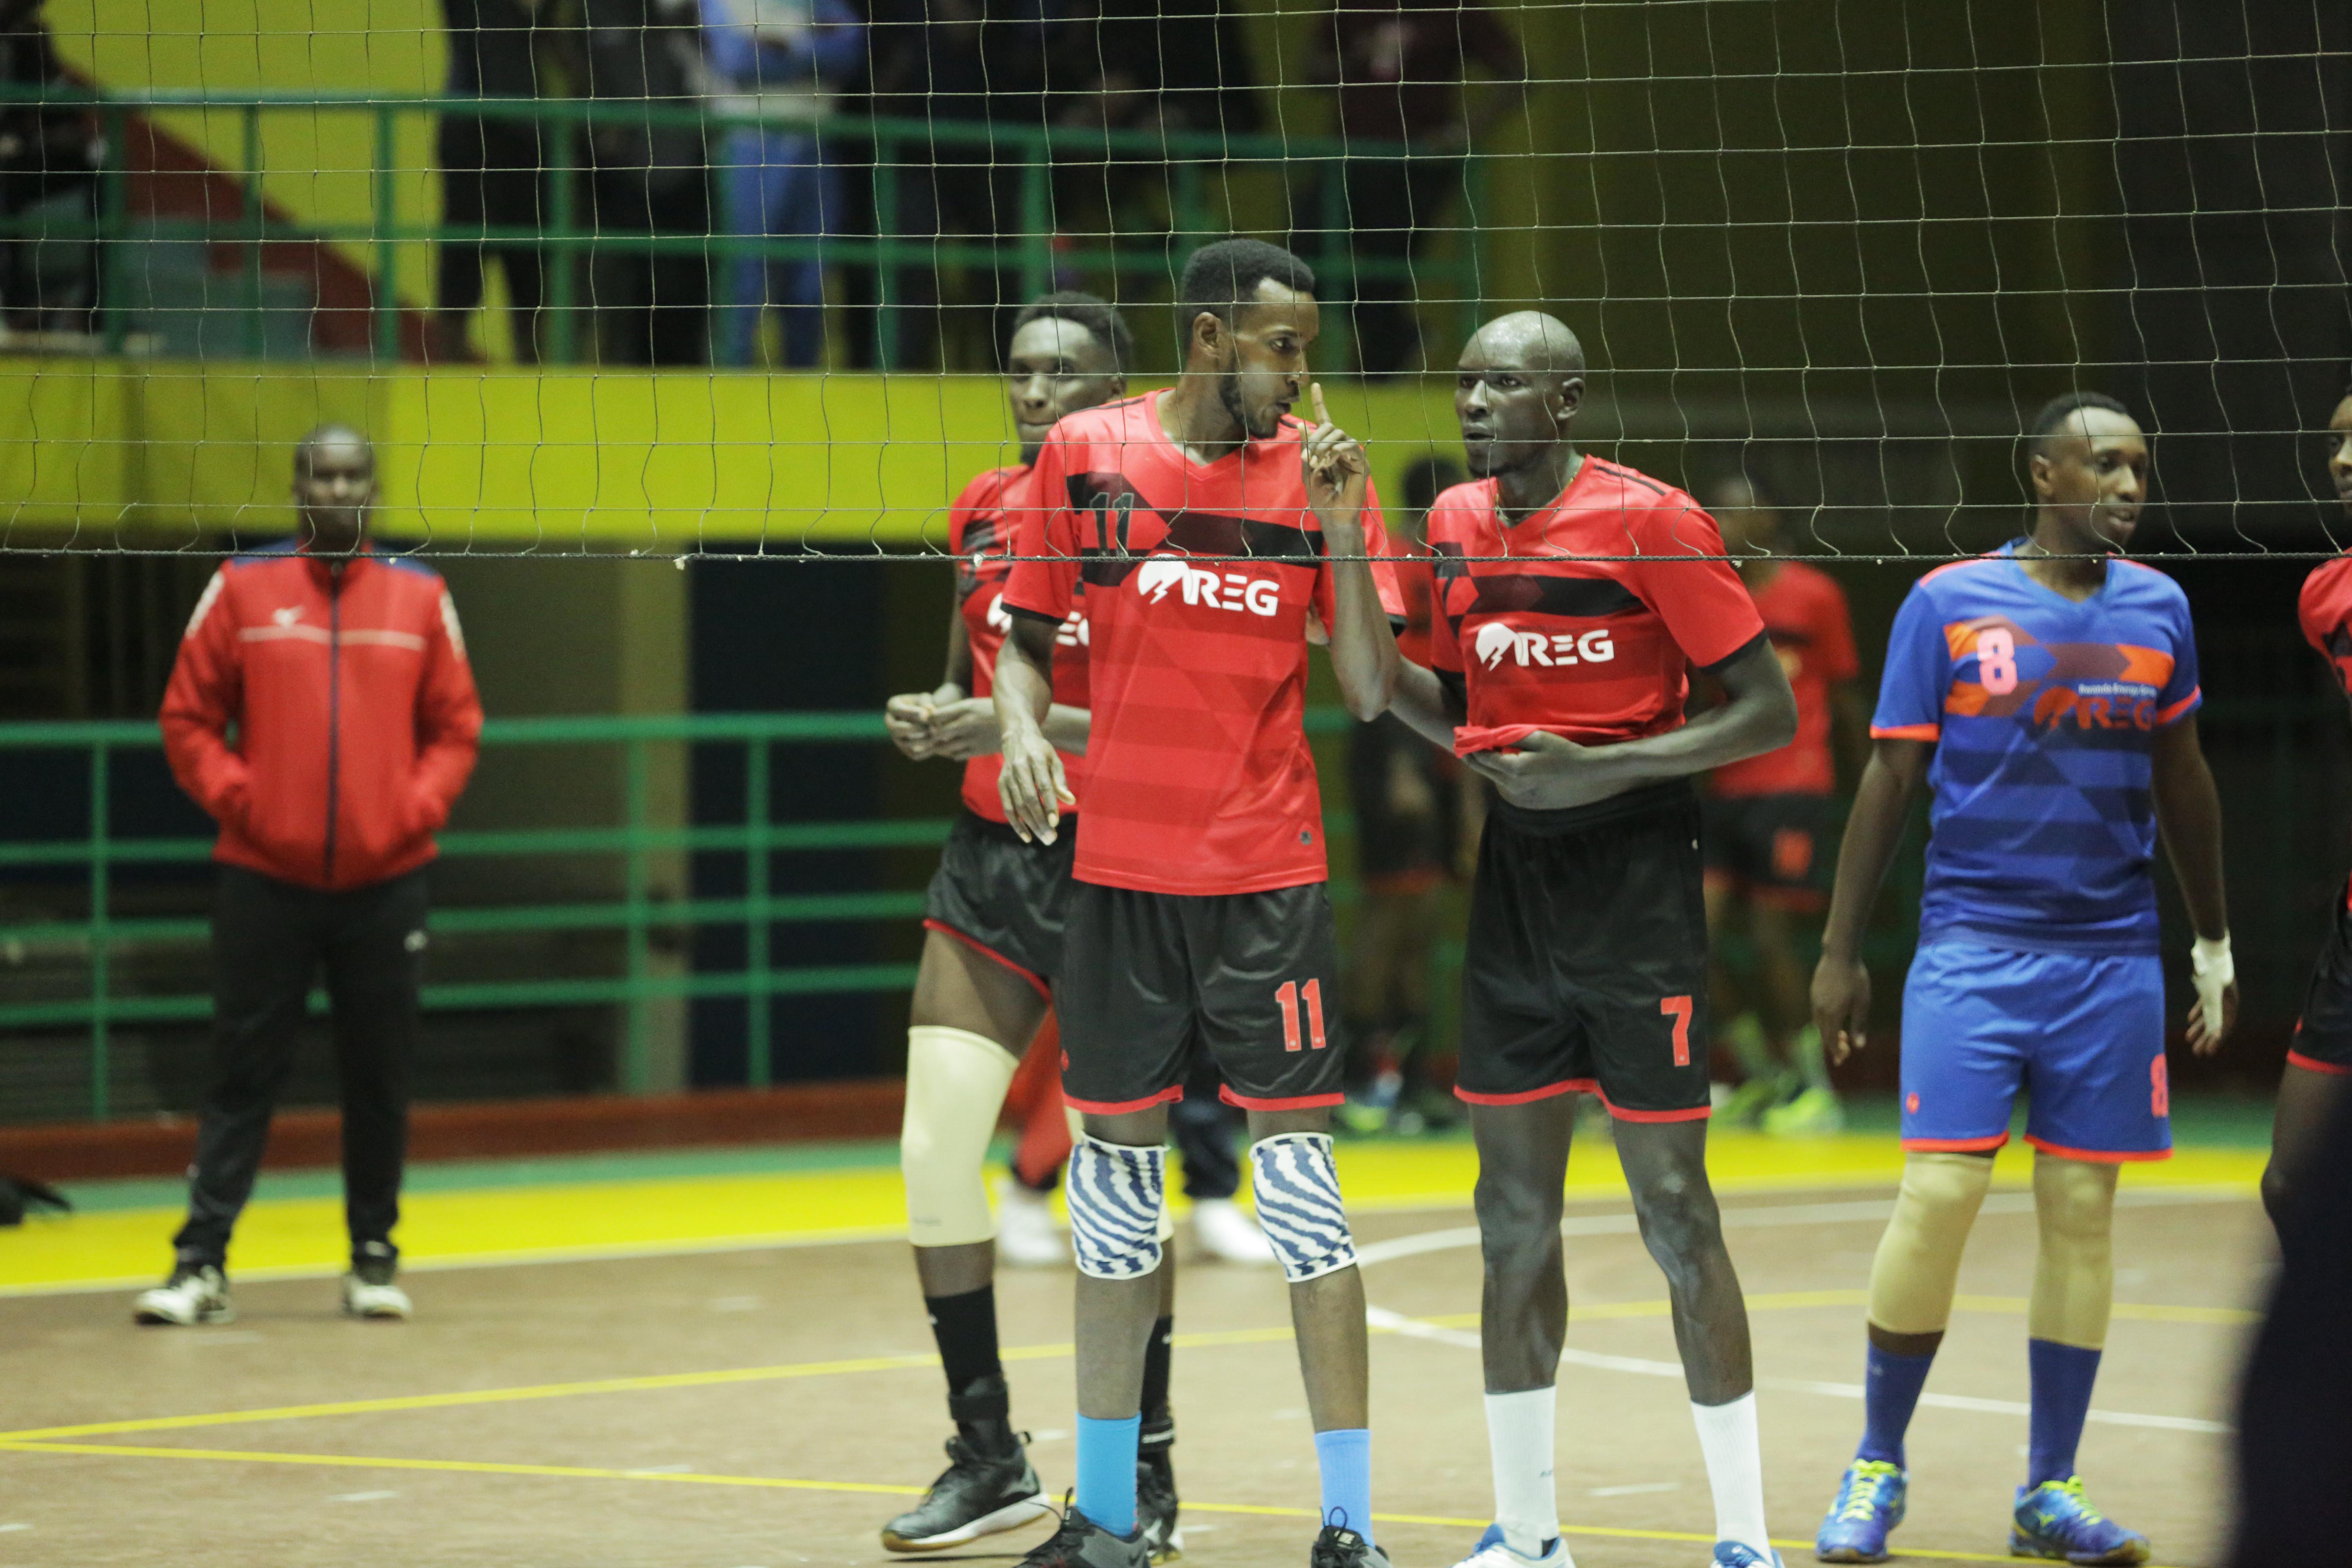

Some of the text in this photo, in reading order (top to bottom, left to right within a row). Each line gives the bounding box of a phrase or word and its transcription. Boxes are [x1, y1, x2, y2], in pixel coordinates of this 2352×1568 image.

[1089, 492, 1134, 558] 11
[1187, 569, 1280, 616] REG
[1517, 629, 1614, 666] REG
[1976, 627, 2018, 695] 8
[2076, 696, 2154, 731] REG
[1274, 978, 1326, 1052] 11
[1660, 995, 1693, 1067] 7
[2150, 1053, 2169, 1118] 8
